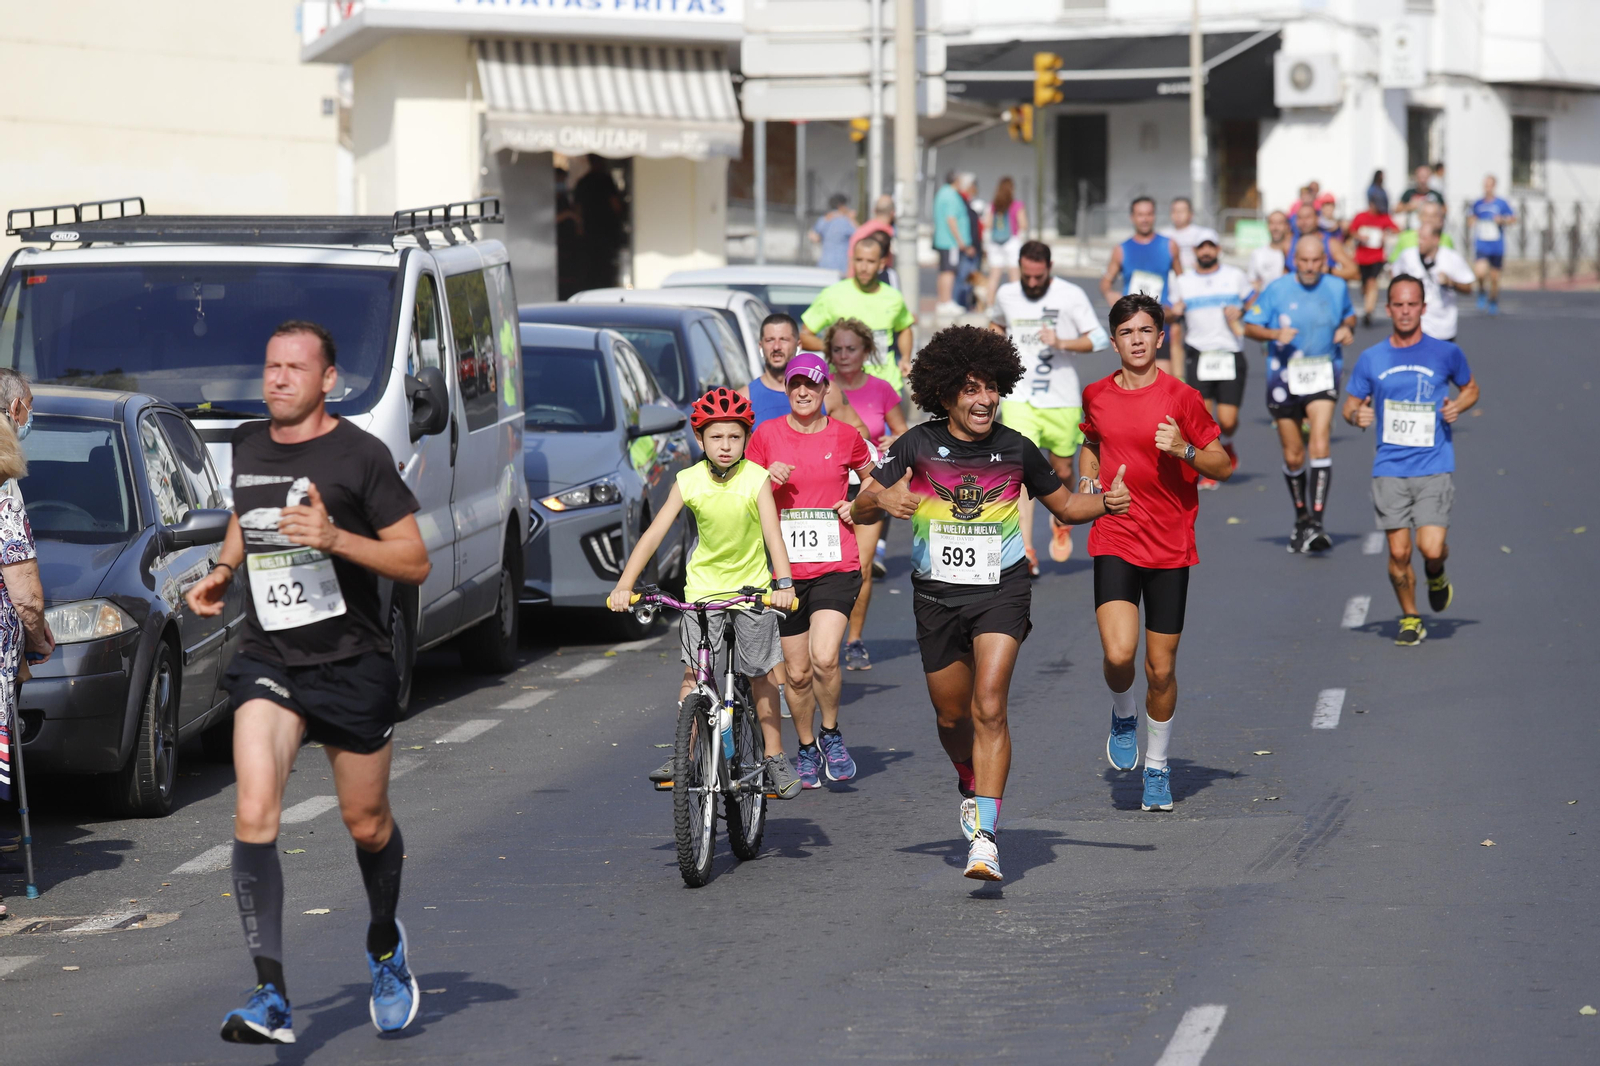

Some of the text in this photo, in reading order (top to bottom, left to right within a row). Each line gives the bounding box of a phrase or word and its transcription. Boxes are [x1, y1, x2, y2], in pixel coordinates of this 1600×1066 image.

[52, 232, 78, 240] CRUZ
[1392, 420, 1416, 434] 607
[790, 511, 808, 519] VUELTA
[809, 511, 814, 519] A
[815, 511, 835, 519] HUELVA
[943, 525, 966, 534] VUELTA
[967, 526, 973, 534] A
[974, 525, 997, 534] HUELVA
[791, 530, 818, 547] 113
[942, 546, 976, 567] 593
[267, 581, 307, 608] 432
